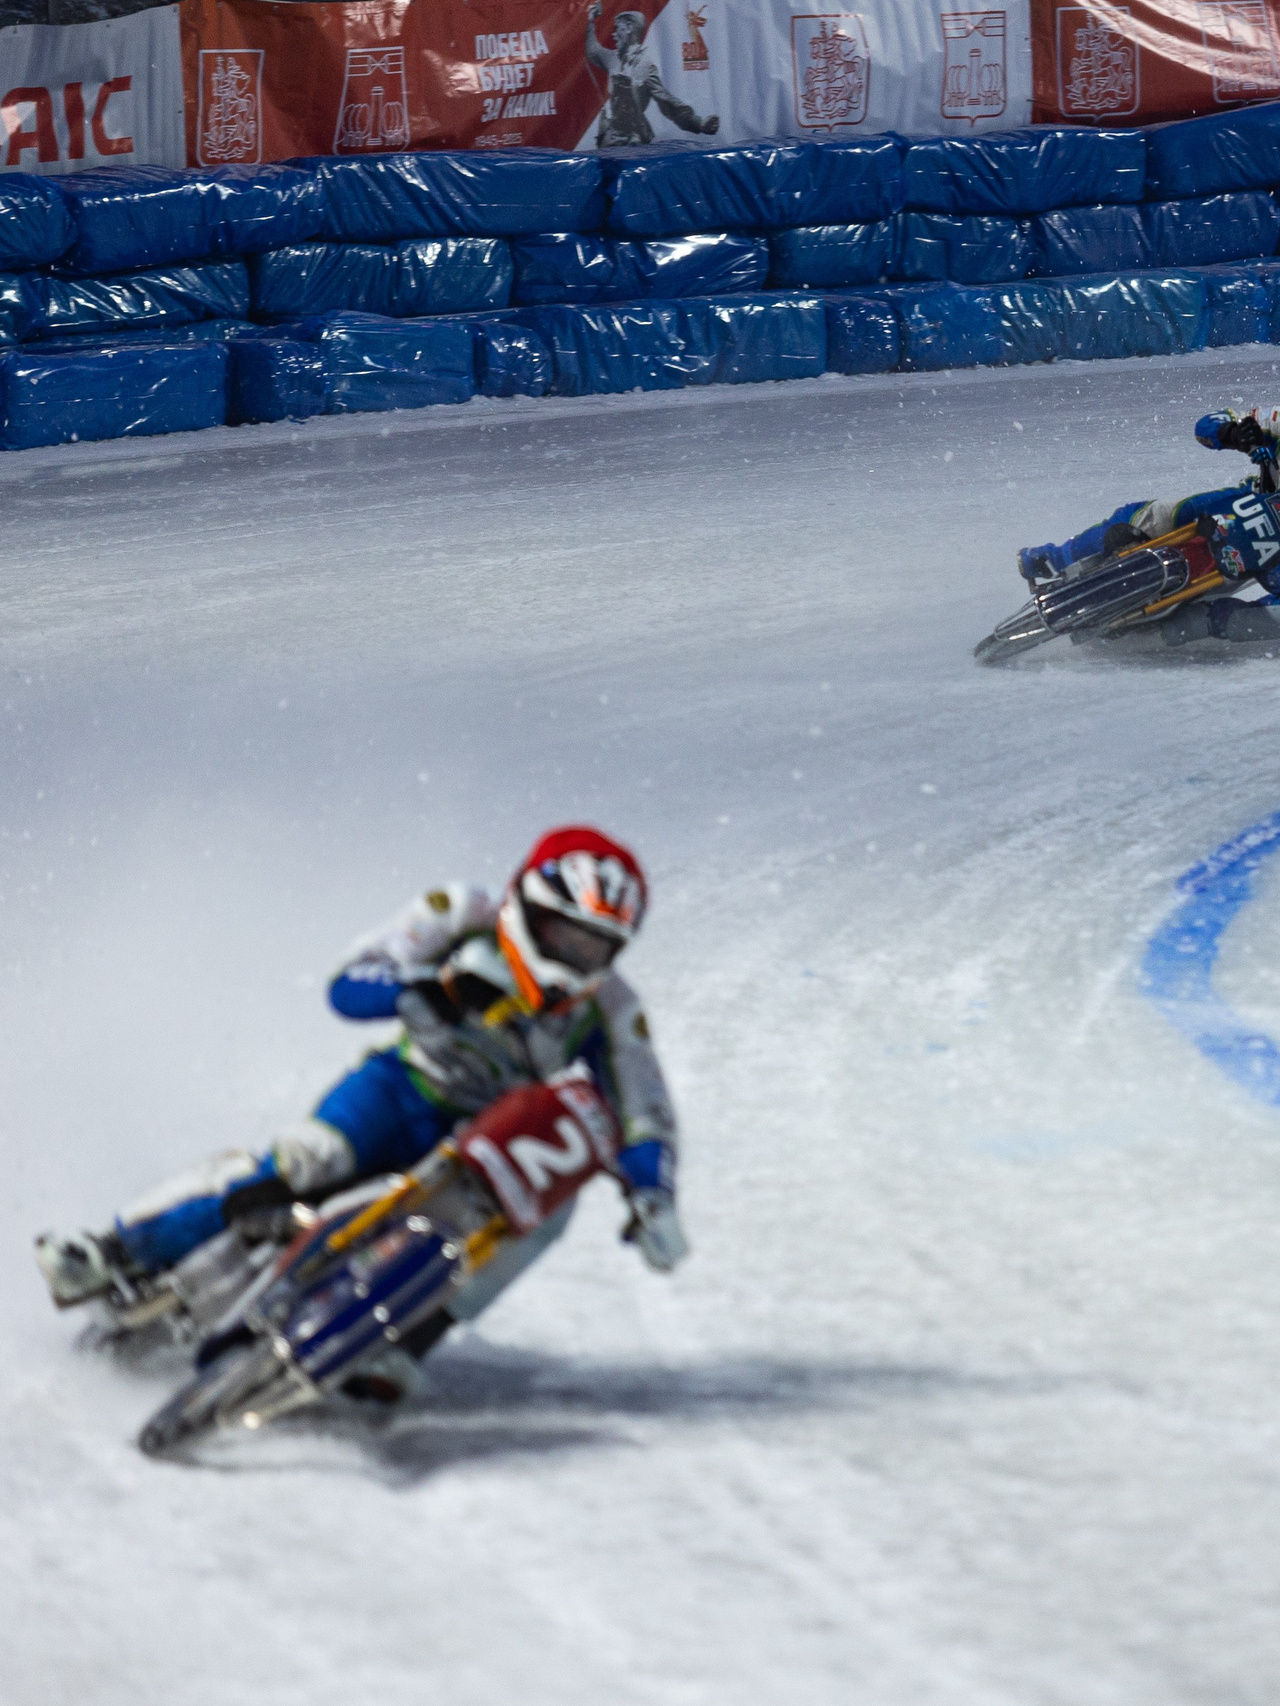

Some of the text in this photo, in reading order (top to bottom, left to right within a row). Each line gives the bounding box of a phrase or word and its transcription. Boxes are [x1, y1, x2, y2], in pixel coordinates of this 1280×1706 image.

[475, 29, 549, 61] ПОБЕДА
[479, 62, 535, 94] БУДЕТ
[481, 90, 558, 123] ЗА НАМИ!
[1232, 493, 1280, 567] UFA
[507, 1115, 591, 1192] 2
